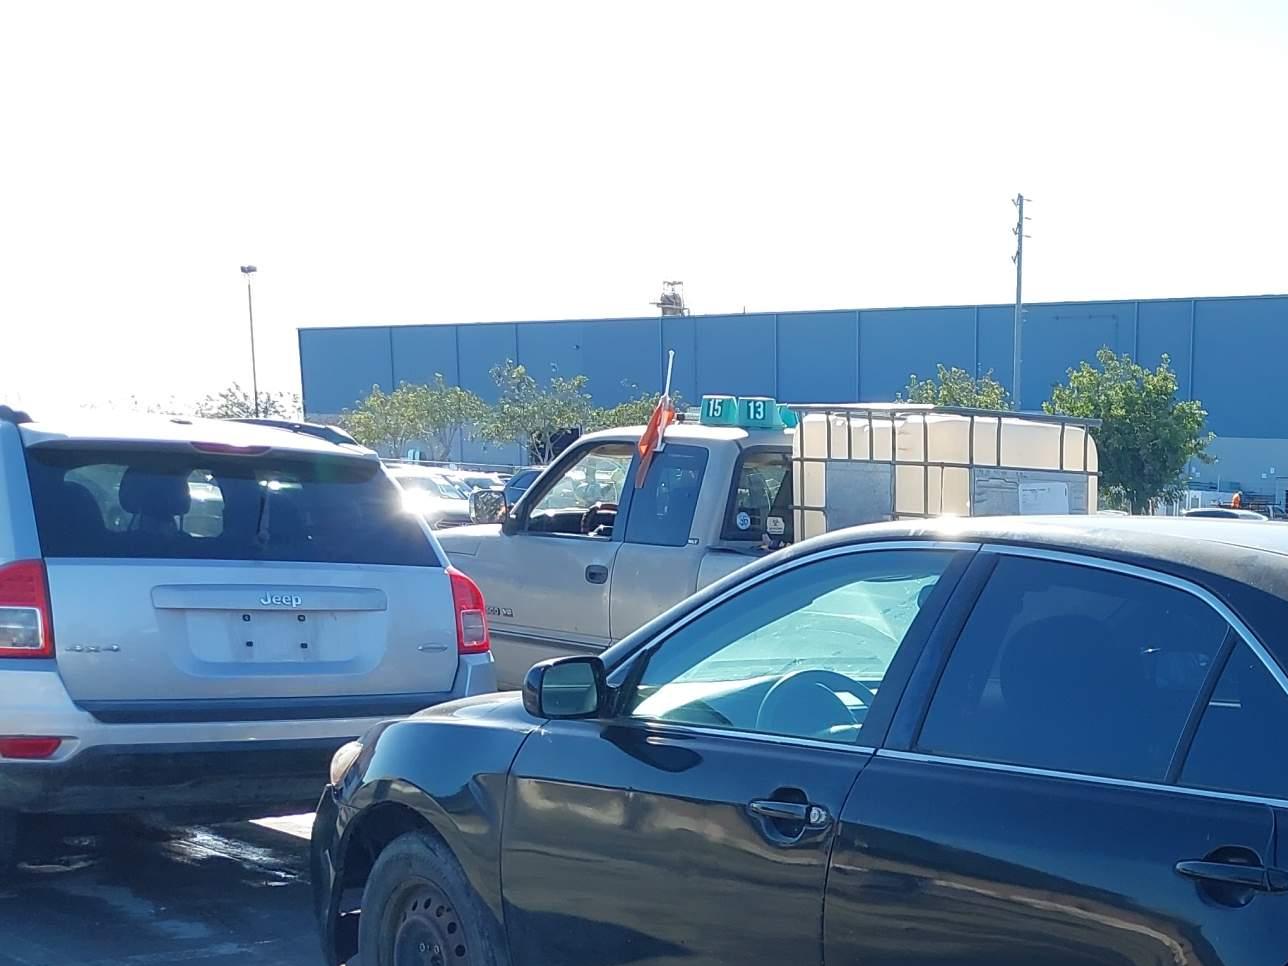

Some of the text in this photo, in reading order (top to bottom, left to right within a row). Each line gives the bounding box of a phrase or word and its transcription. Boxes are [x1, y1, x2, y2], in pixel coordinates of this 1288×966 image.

[708, 399, 722, 417] 15
[748, 400, 764, 420] 13
[260, 591, 303, 608] Jeep
